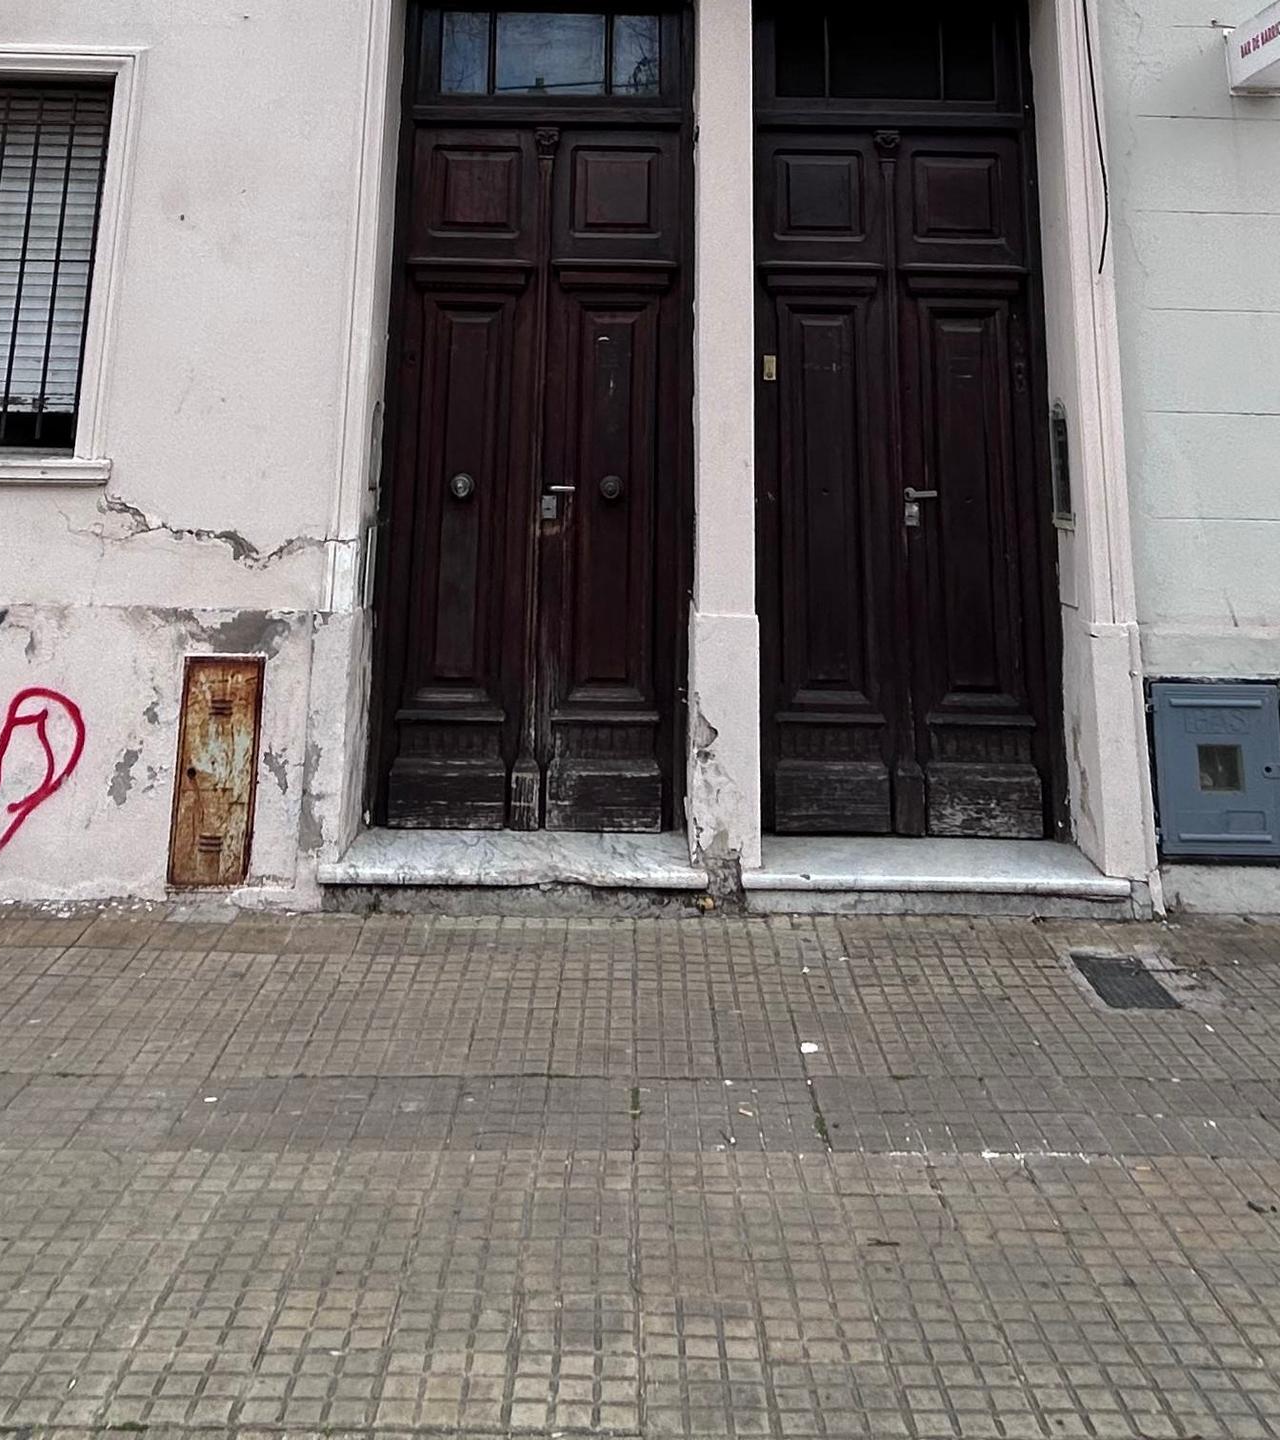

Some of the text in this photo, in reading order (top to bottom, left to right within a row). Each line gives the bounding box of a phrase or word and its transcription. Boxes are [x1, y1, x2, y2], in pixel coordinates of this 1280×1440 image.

[1240, 40, 1252, 59] BAR
[1252, 34, 1260, 51] DE
[1184, 708, 1249, 735] GAS
